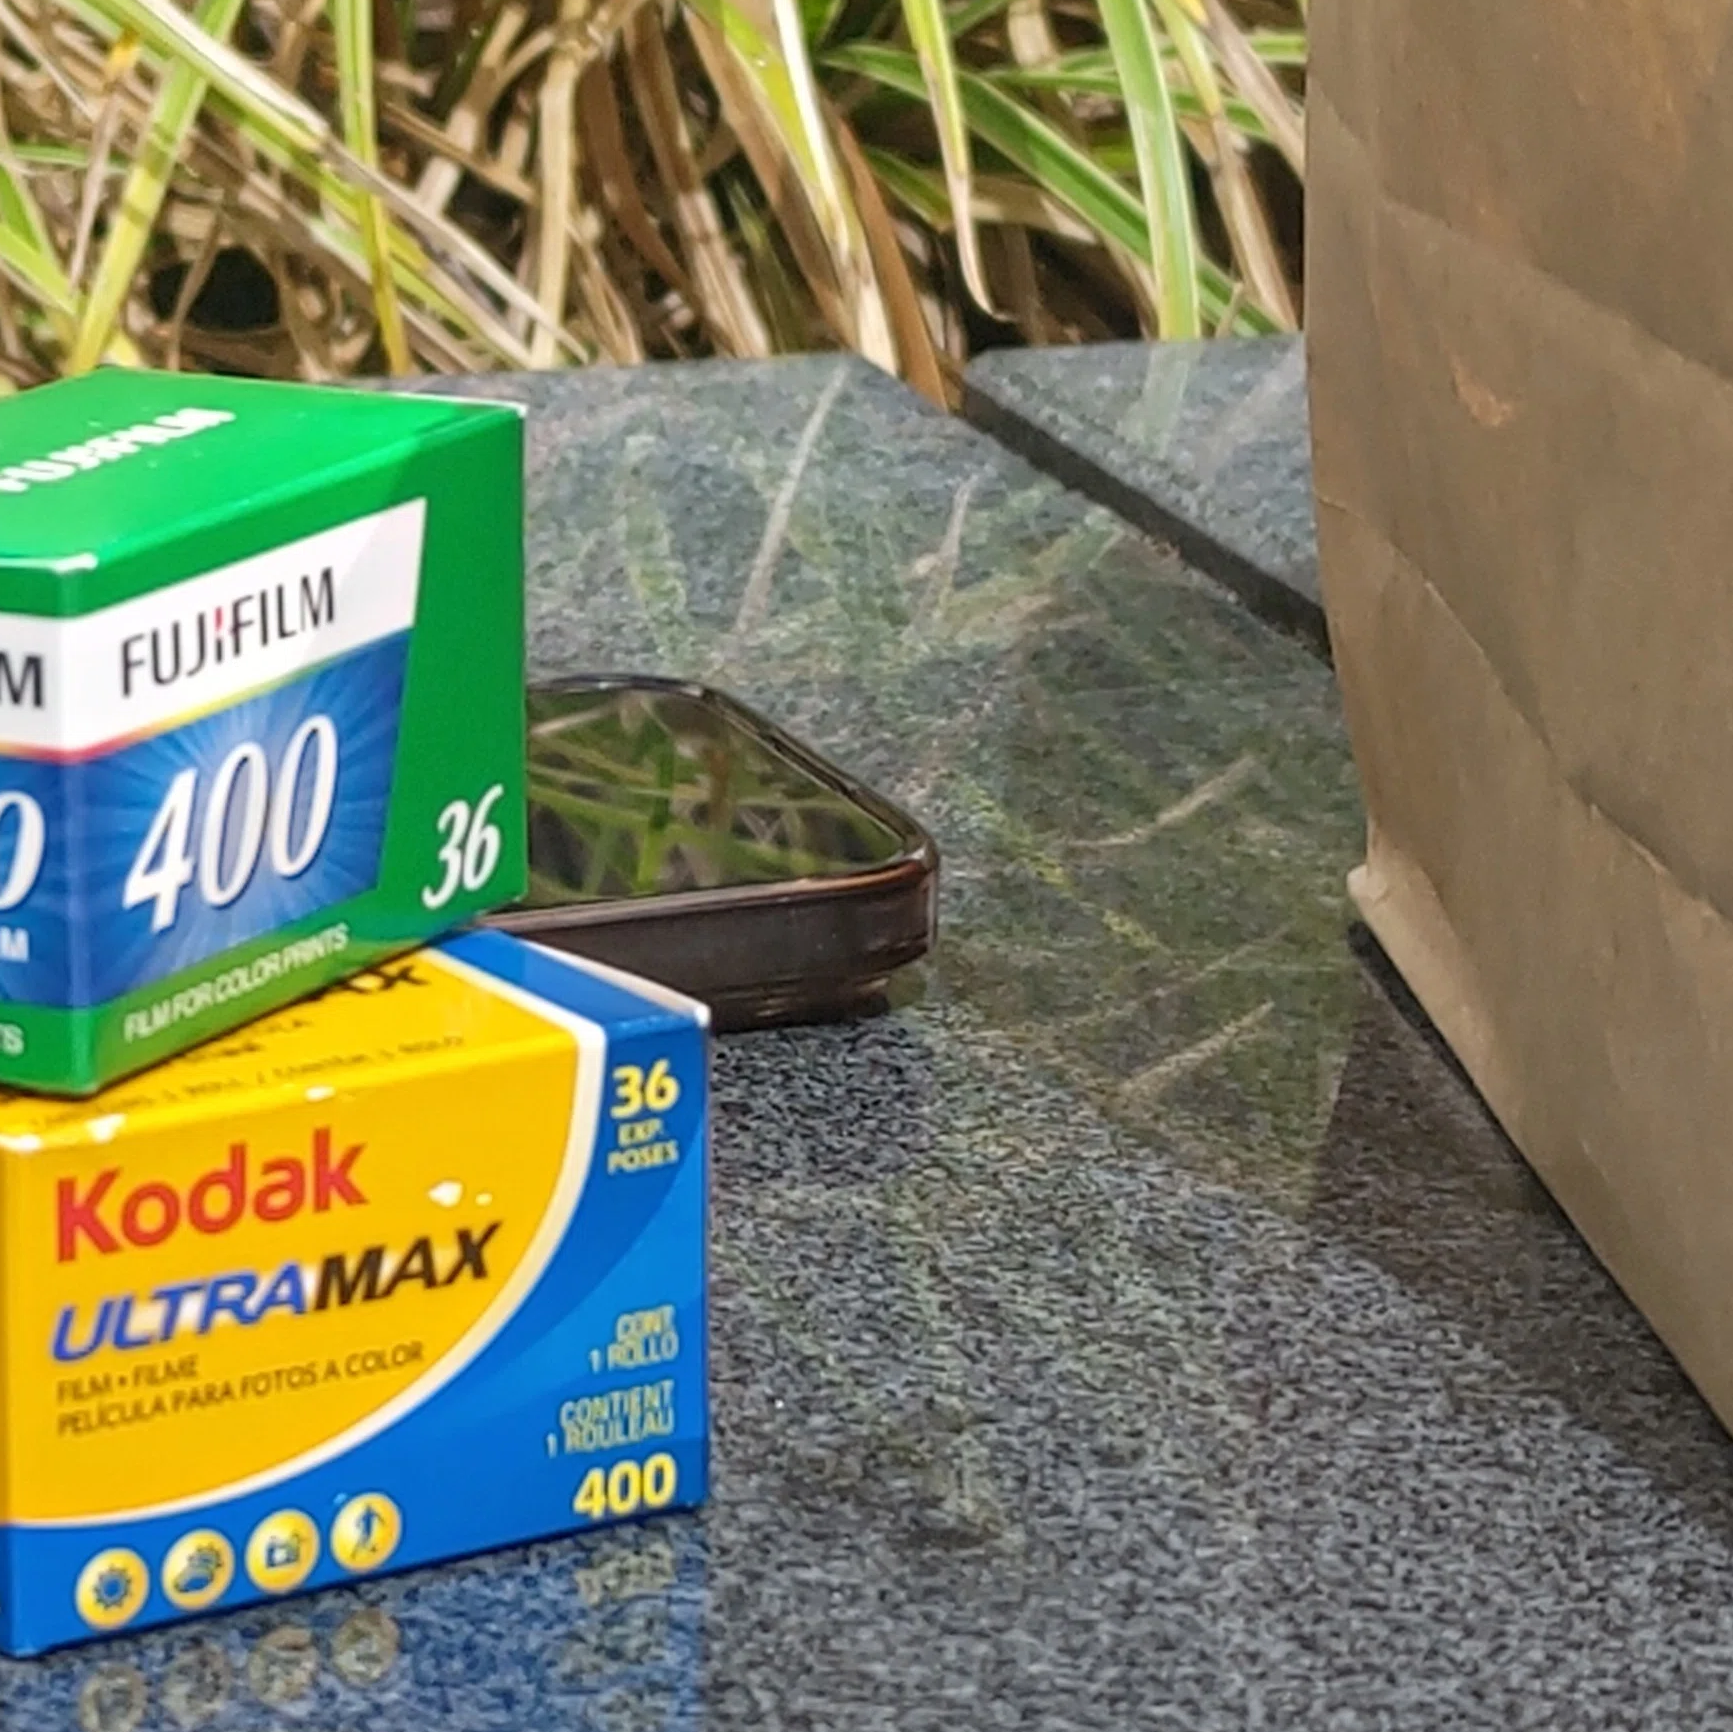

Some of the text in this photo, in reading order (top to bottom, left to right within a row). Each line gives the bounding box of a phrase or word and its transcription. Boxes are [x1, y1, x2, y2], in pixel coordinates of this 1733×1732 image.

[120, 566, 336, 698] FUJIFILM
[121, 713, 340, 934] 400
[420, 783, 505, 910] 36
[124, 1000, 171, 1044] FILM
[170, 980, 214, 1021] FOR
[215, 951, 284, 1004] COLOR
[281, 921, 350, 972] PRINTS
[609, 1057, 681, 1119] 36
[606, 1138, 680, 1176] POSES
[56, 1126, 371, 1265] Kodak
[51, 1220, 505, 1363] ULTRAMAX
[56, 1354, 199, 1405] FILM FILME
[171, 1380, 235, 1414] PARA
[238, 1361, 317, 1401] FOTOS
[321, 1356, 342, 1382] A
[344, 1340, 425, 1377] COLOR
[588, 1348, 602, 1375] 1
[546, 1432, 558, 1459] 1
[573, 1452, 677, 1520] 400
